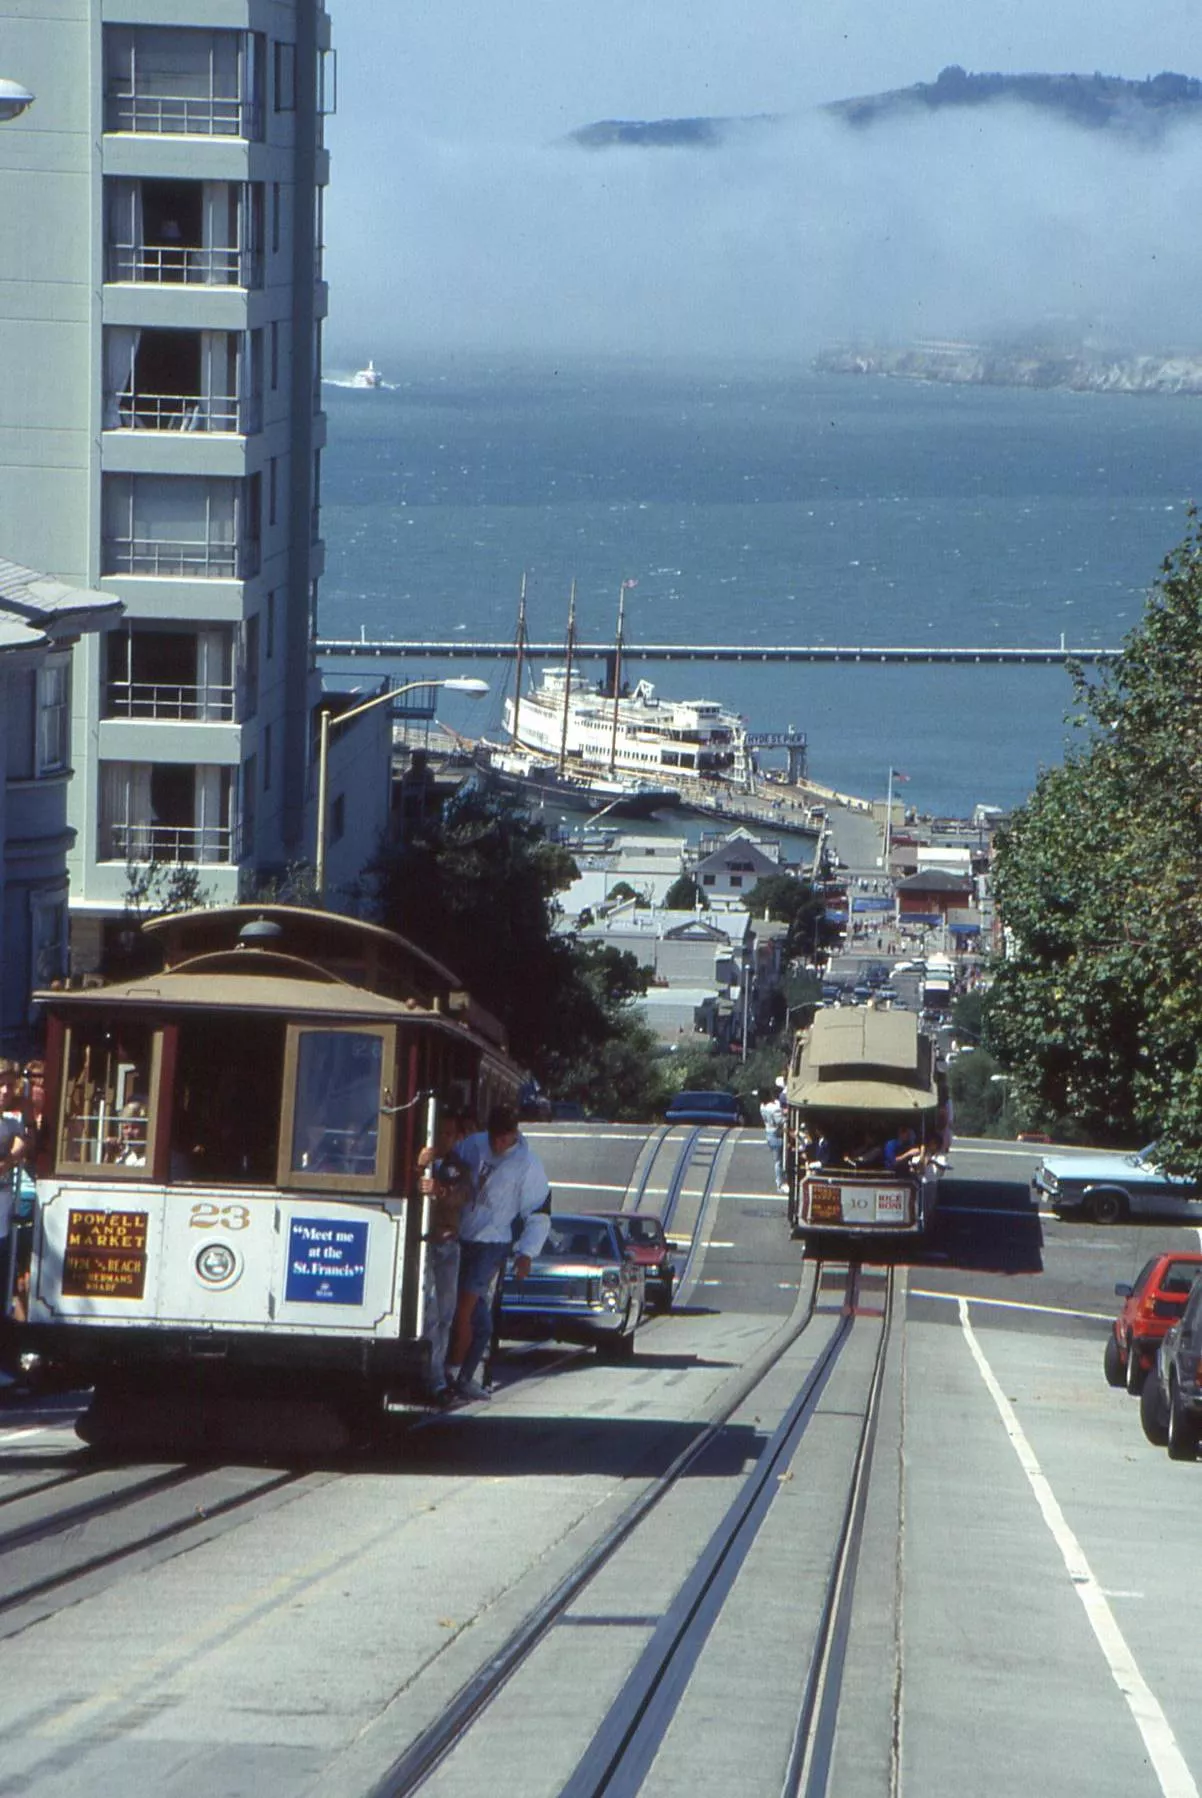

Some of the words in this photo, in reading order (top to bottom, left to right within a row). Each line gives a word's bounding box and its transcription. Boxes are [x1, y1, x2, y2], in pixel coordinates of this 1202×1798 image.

[850, 1198, 868, 1209] 10
[71, 1212, 145, 1228] POWELL
[189, 1202, 250, 1230] 23
[91, 1226, 127, 1236] AND
[336, 1232, 355, 1243] me
[69, 1233, 145, 1248] MARKET
[308, 1247, 321, 1257] at
[323, 1246, 343, 1259] the
